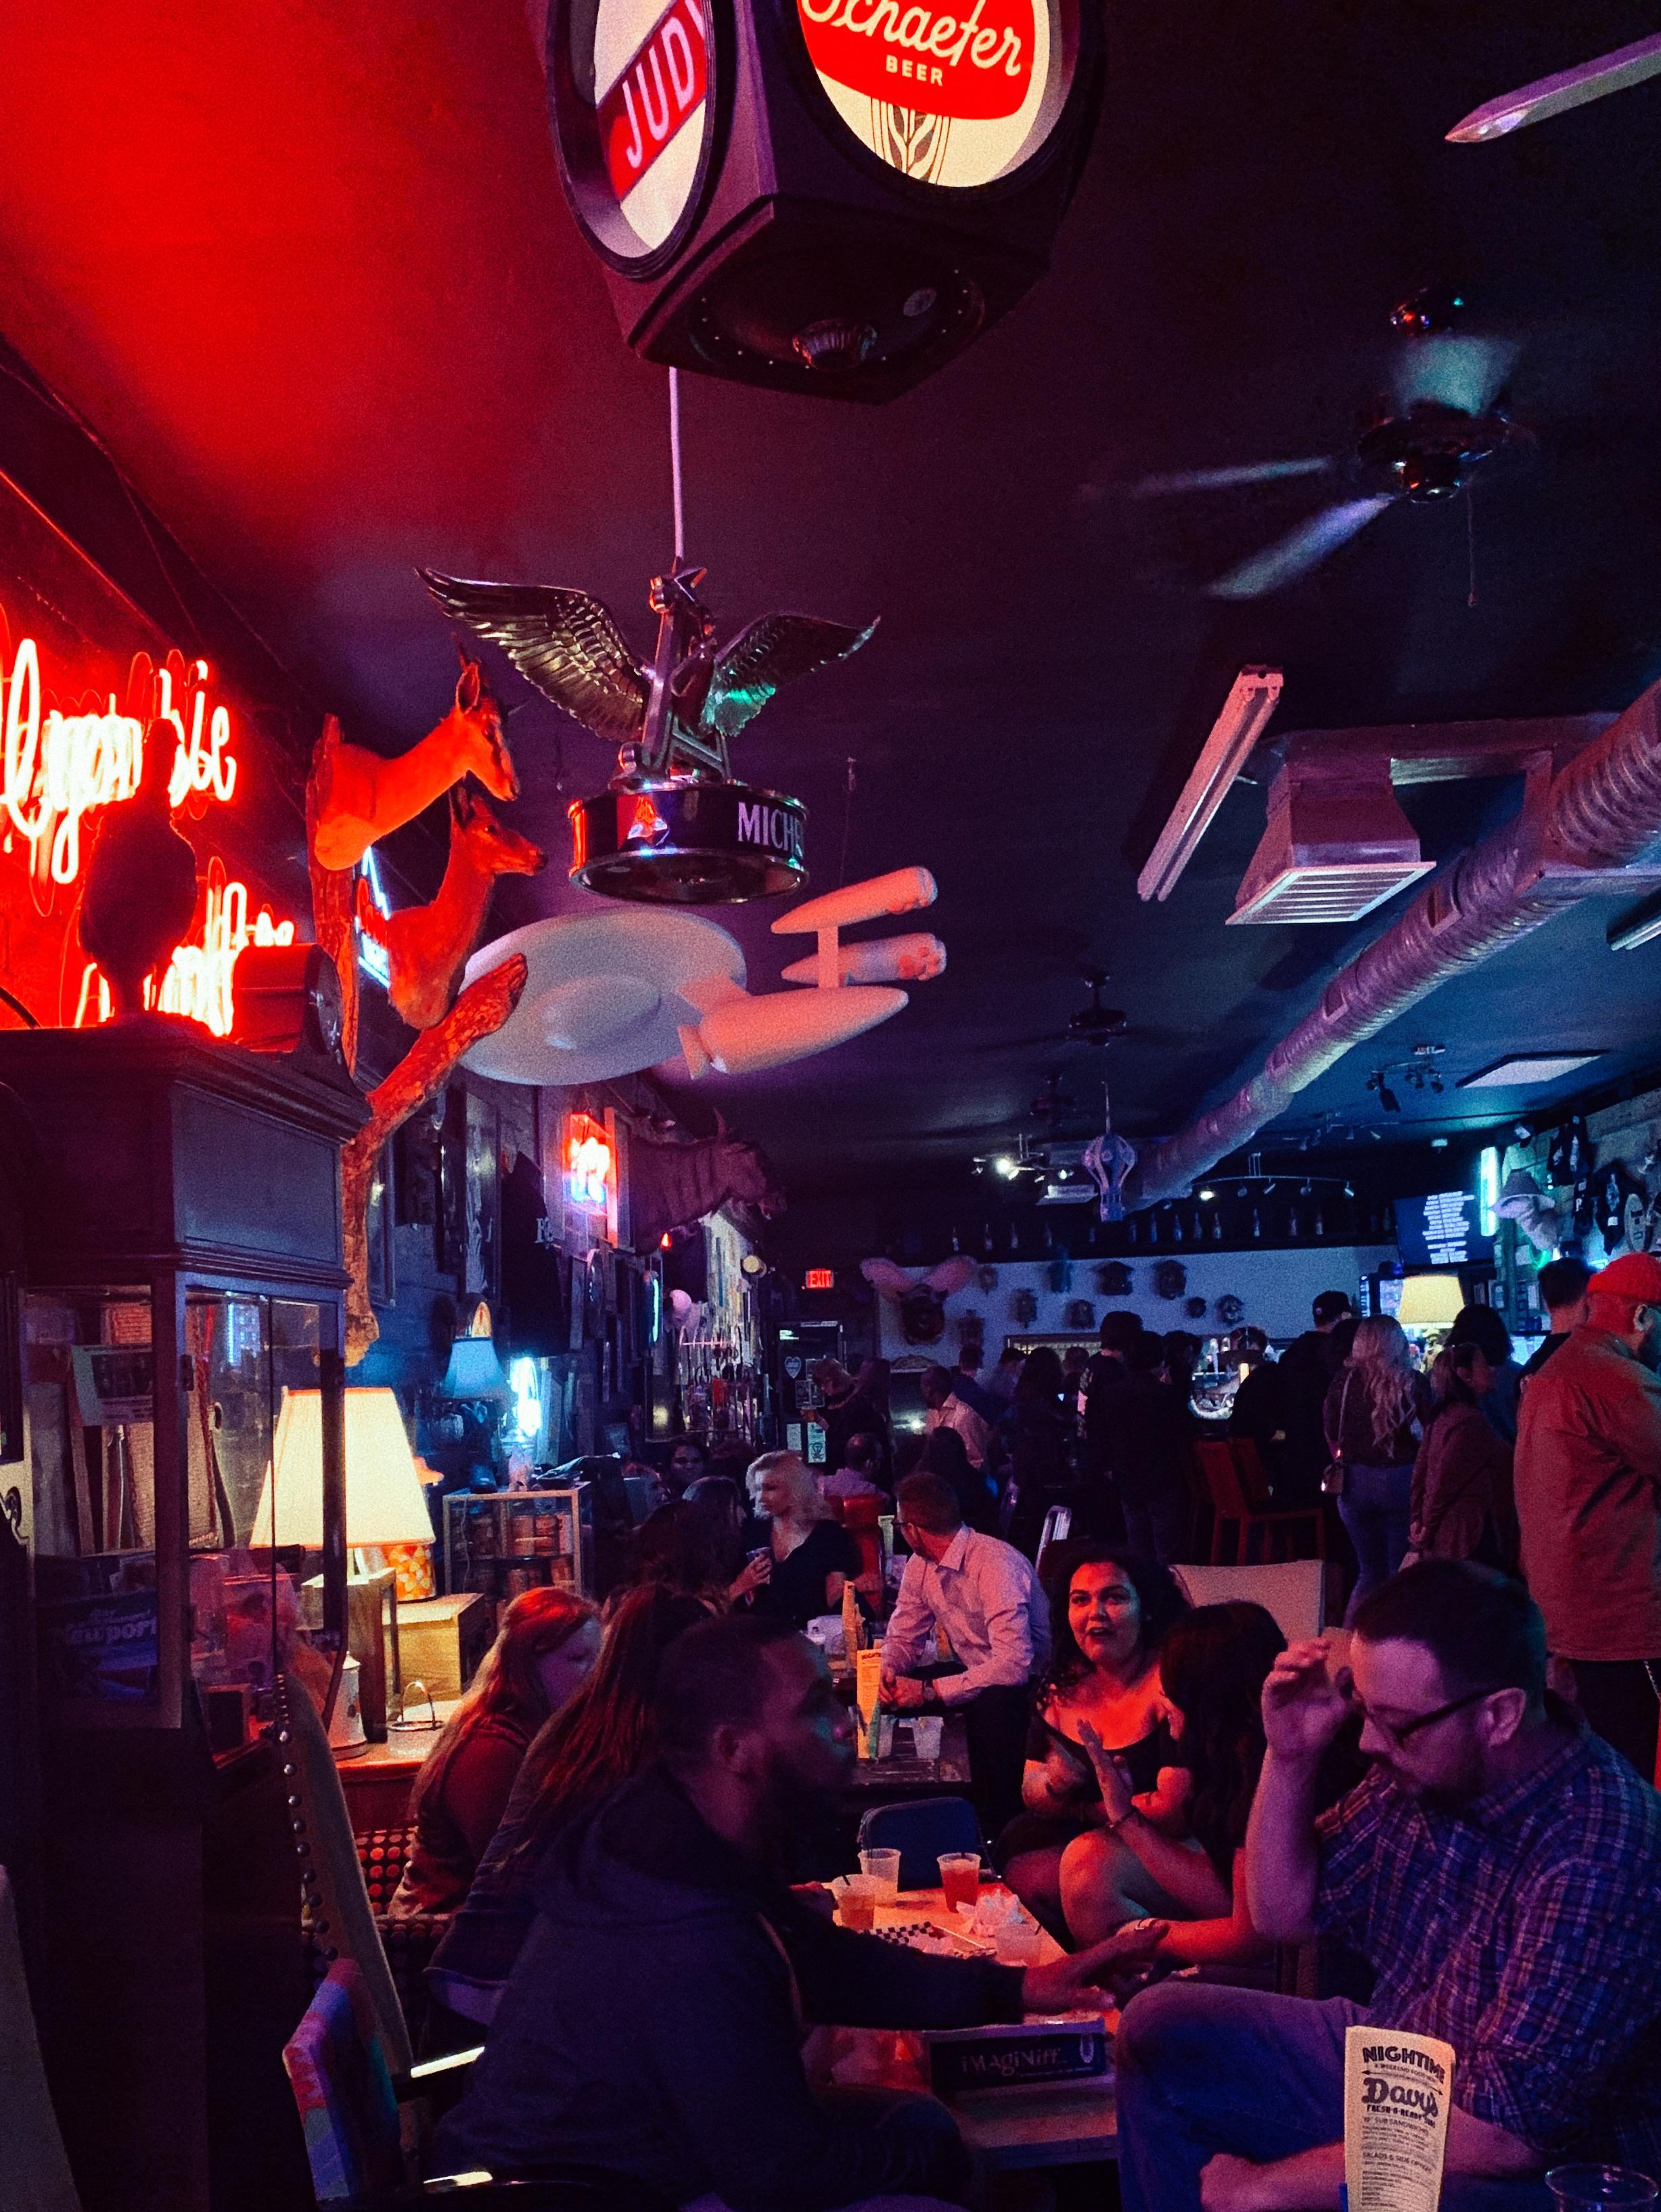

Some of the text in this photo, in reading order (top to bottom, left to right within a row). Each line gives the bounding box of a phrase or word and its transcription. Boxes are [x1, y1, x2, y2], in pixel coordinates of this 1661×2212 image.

[886, 55, 943, 87] BEER
[809, 1270, 831, 1288] EXIT
[1362, 2046, 1445, 2084] NIGHTIME
